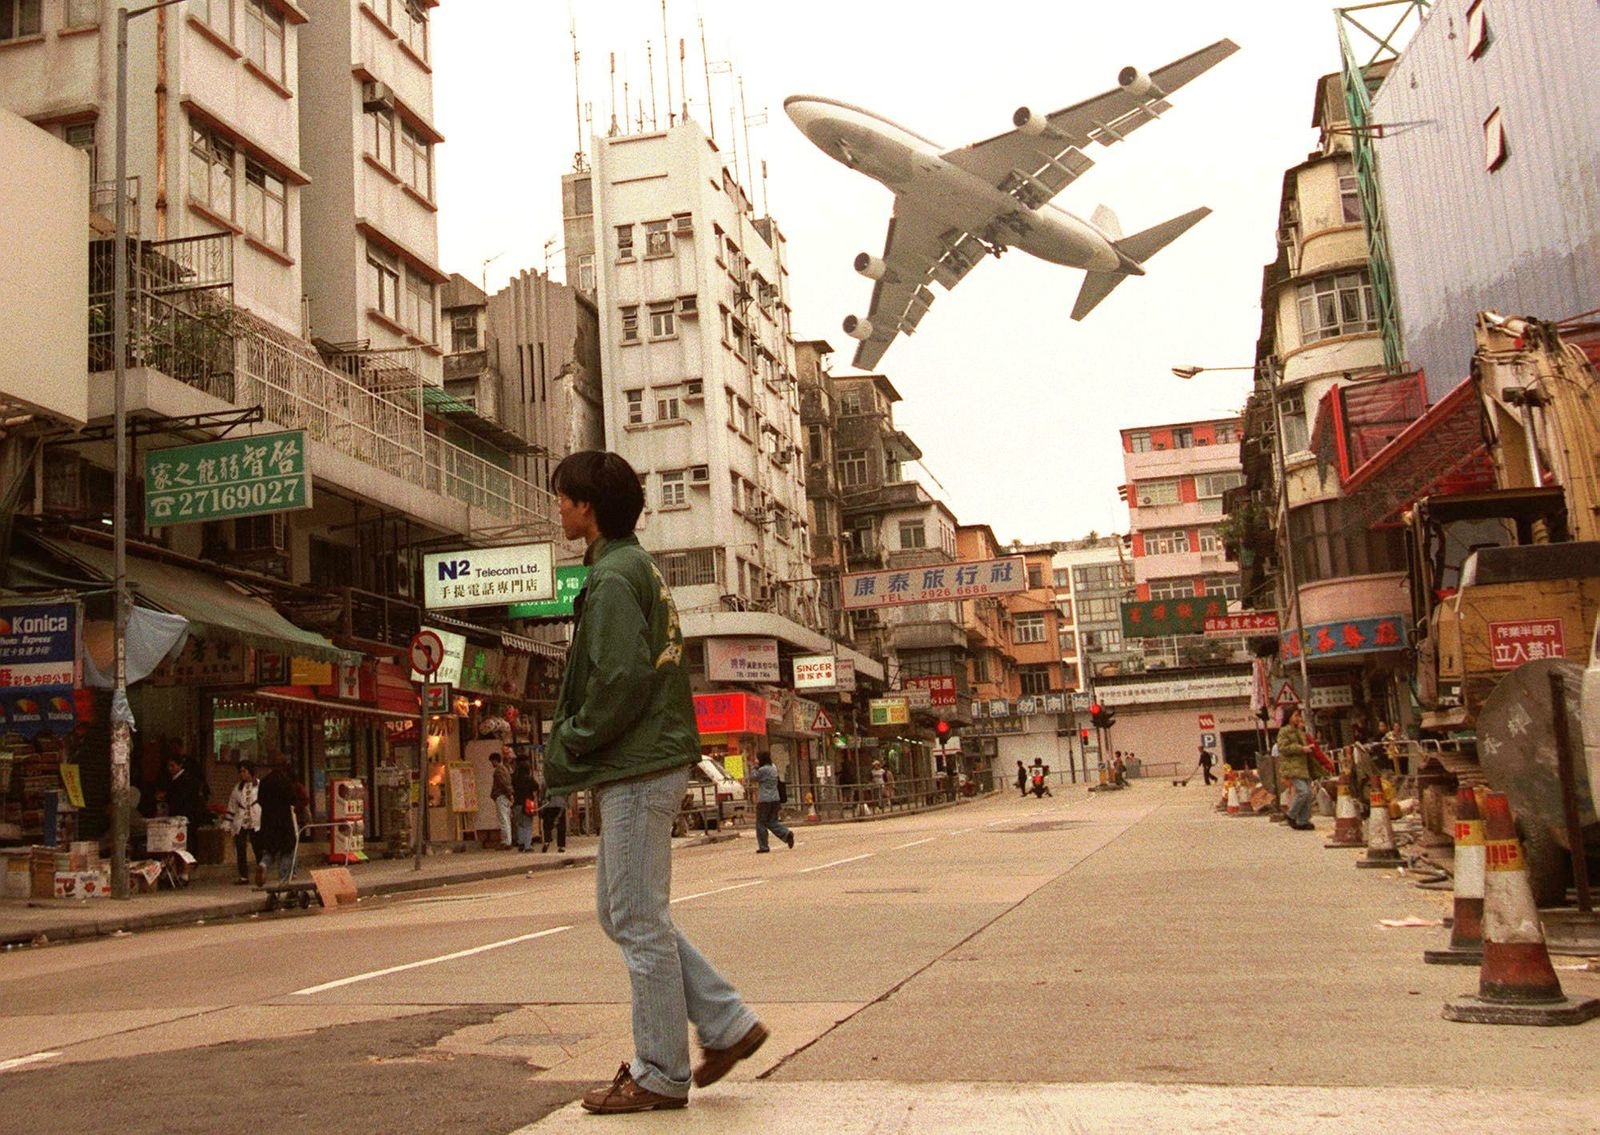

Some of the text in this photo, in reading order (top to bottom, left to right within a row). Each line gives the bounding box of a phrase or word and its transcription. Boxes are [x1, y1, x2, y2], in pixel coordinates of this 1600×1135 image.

[179, 478, 300, 516] 27169027
[438, 560, 540, 581] N2 Telecom Ltd.
[854, 562, 1013, 597] 康泰旅行社
[440, 578, 538, 599] 手提電話專門店
[12, 614, 67, 634] Konica
[1495, 640, 1562, 662] 立入禁止
[796, 663, 832, 673] SINGER
[1204, 735, 1214, 747] P
